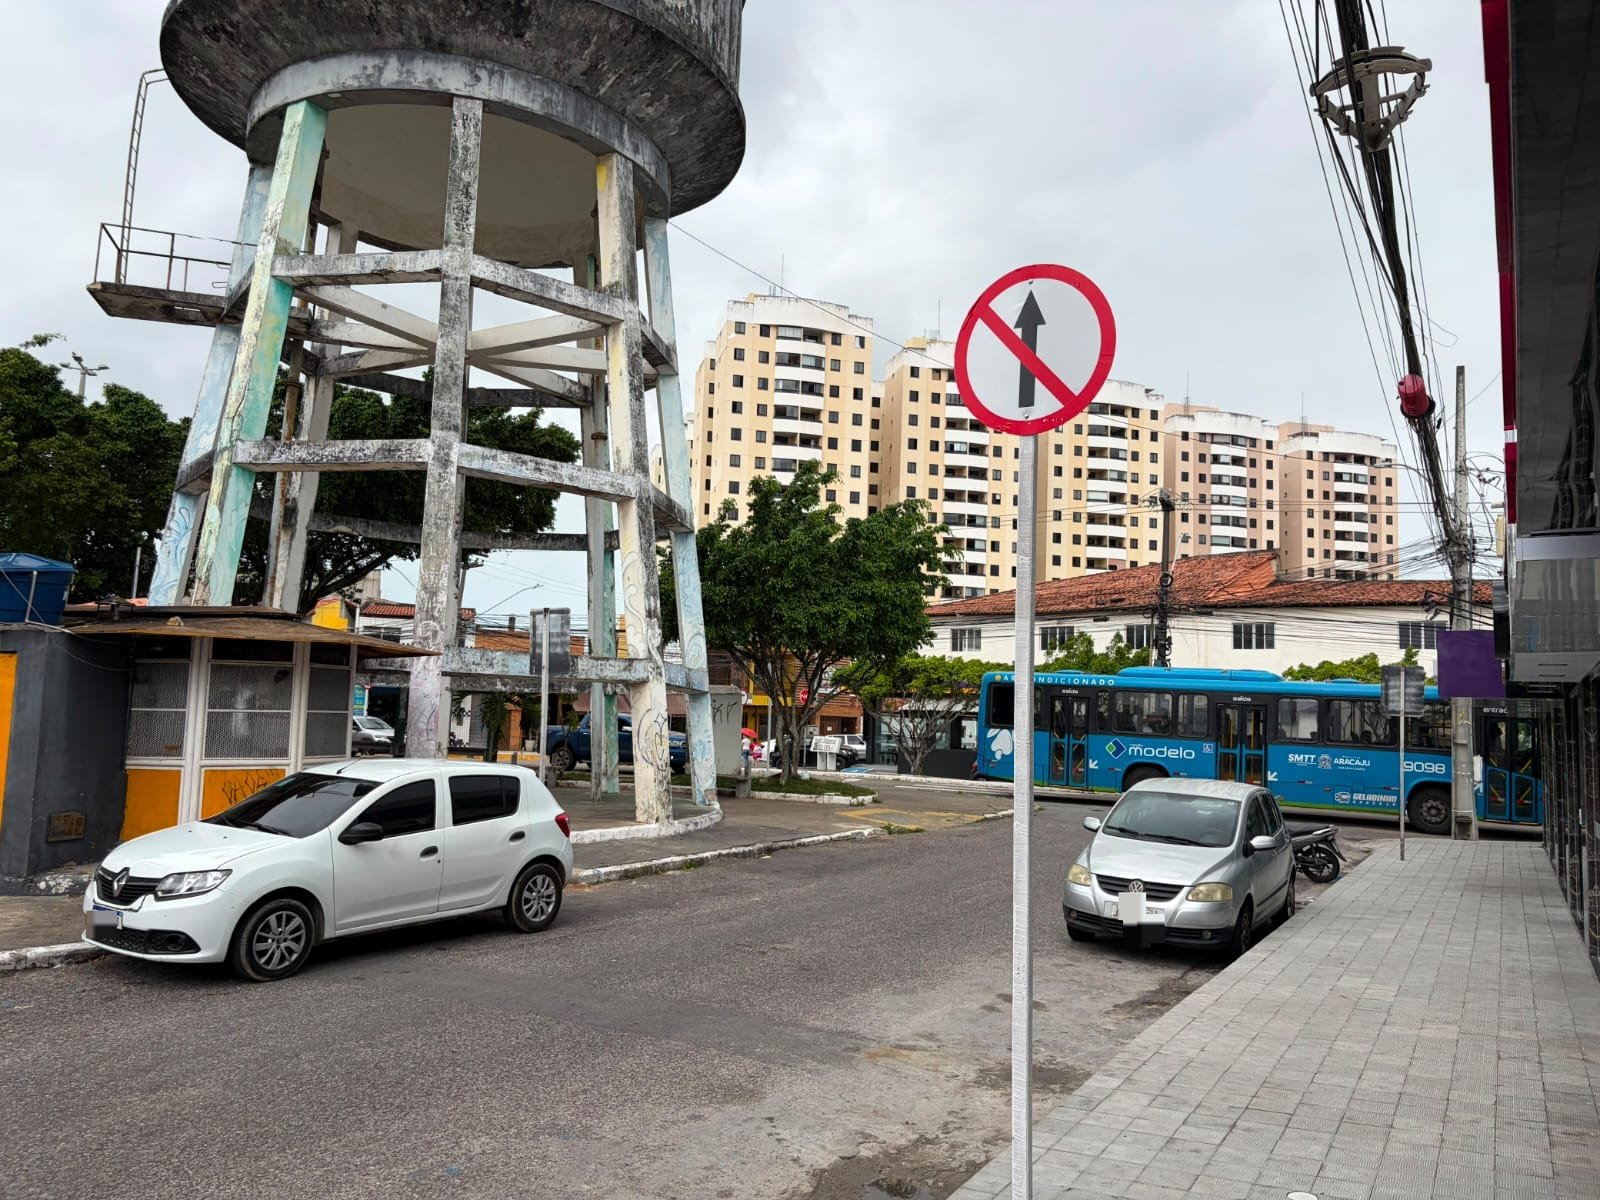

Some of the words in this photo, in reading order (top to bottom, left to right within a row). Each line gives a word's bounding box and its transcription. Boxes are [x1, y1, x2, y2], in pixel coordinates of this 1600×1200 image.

[1033, 676, 1115, 686] NDICIONADO
[1128, 746, 1196, 759] modelo
[1288, 753, 1316, 763] SMTT
[1333, 758, 1371, 767] ARACAJU
[1404, 761, 1446, 774] 9098
